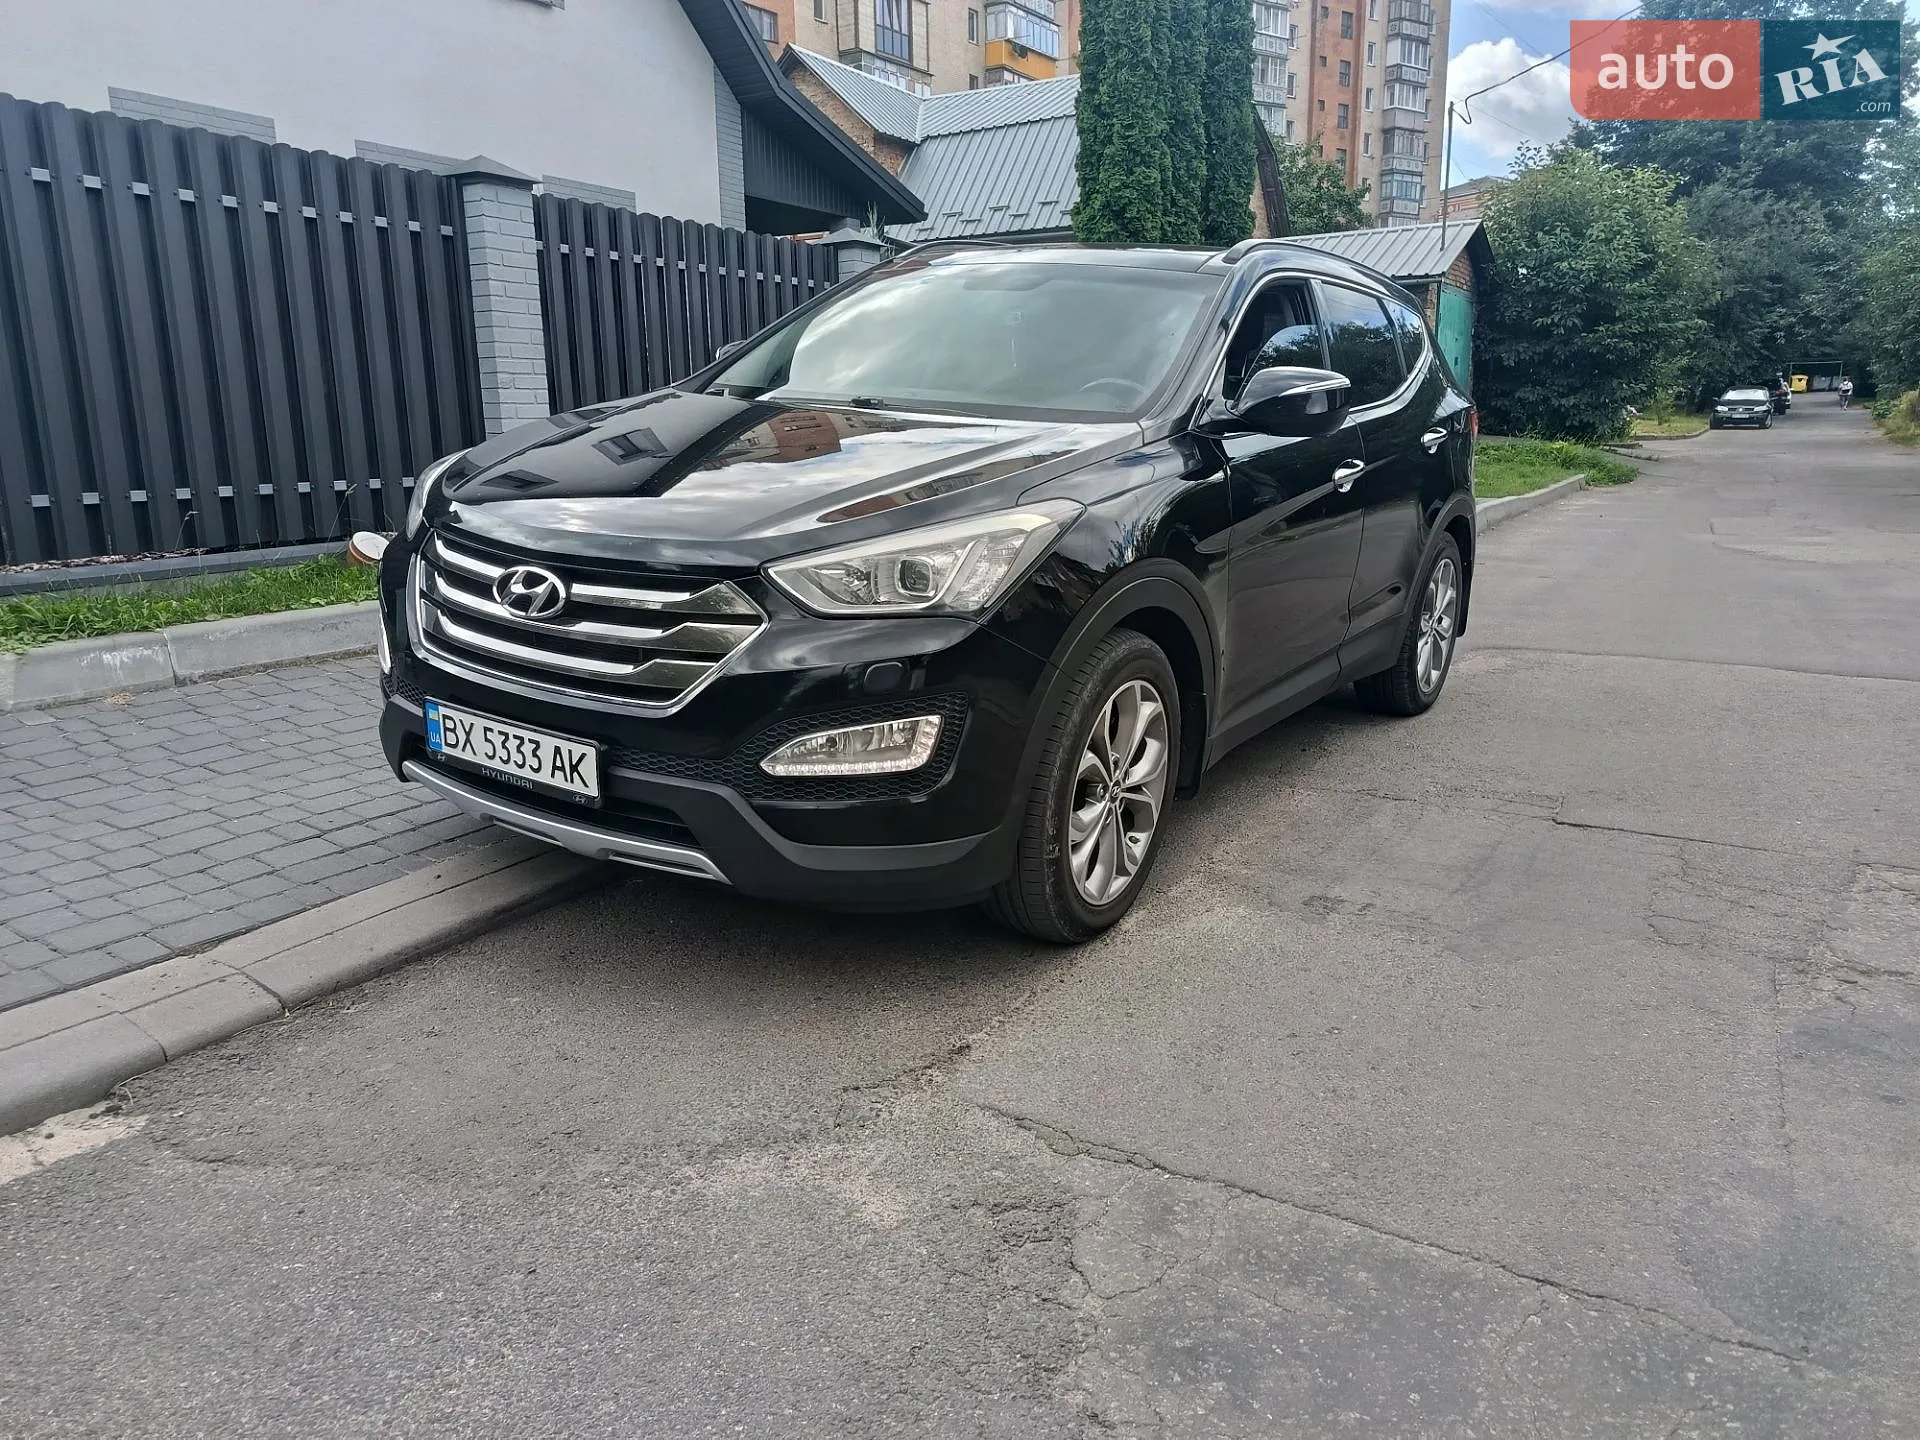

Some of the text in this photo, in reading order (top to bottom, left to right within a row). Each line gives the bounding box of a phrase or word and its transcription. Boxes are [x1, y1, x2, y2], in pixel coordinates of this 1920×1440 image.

[430, 731, 441, 744] UA
[442, 713, 589, 788] BX 5333 AK
[482, 767, 533, 790] HYUNDAI
